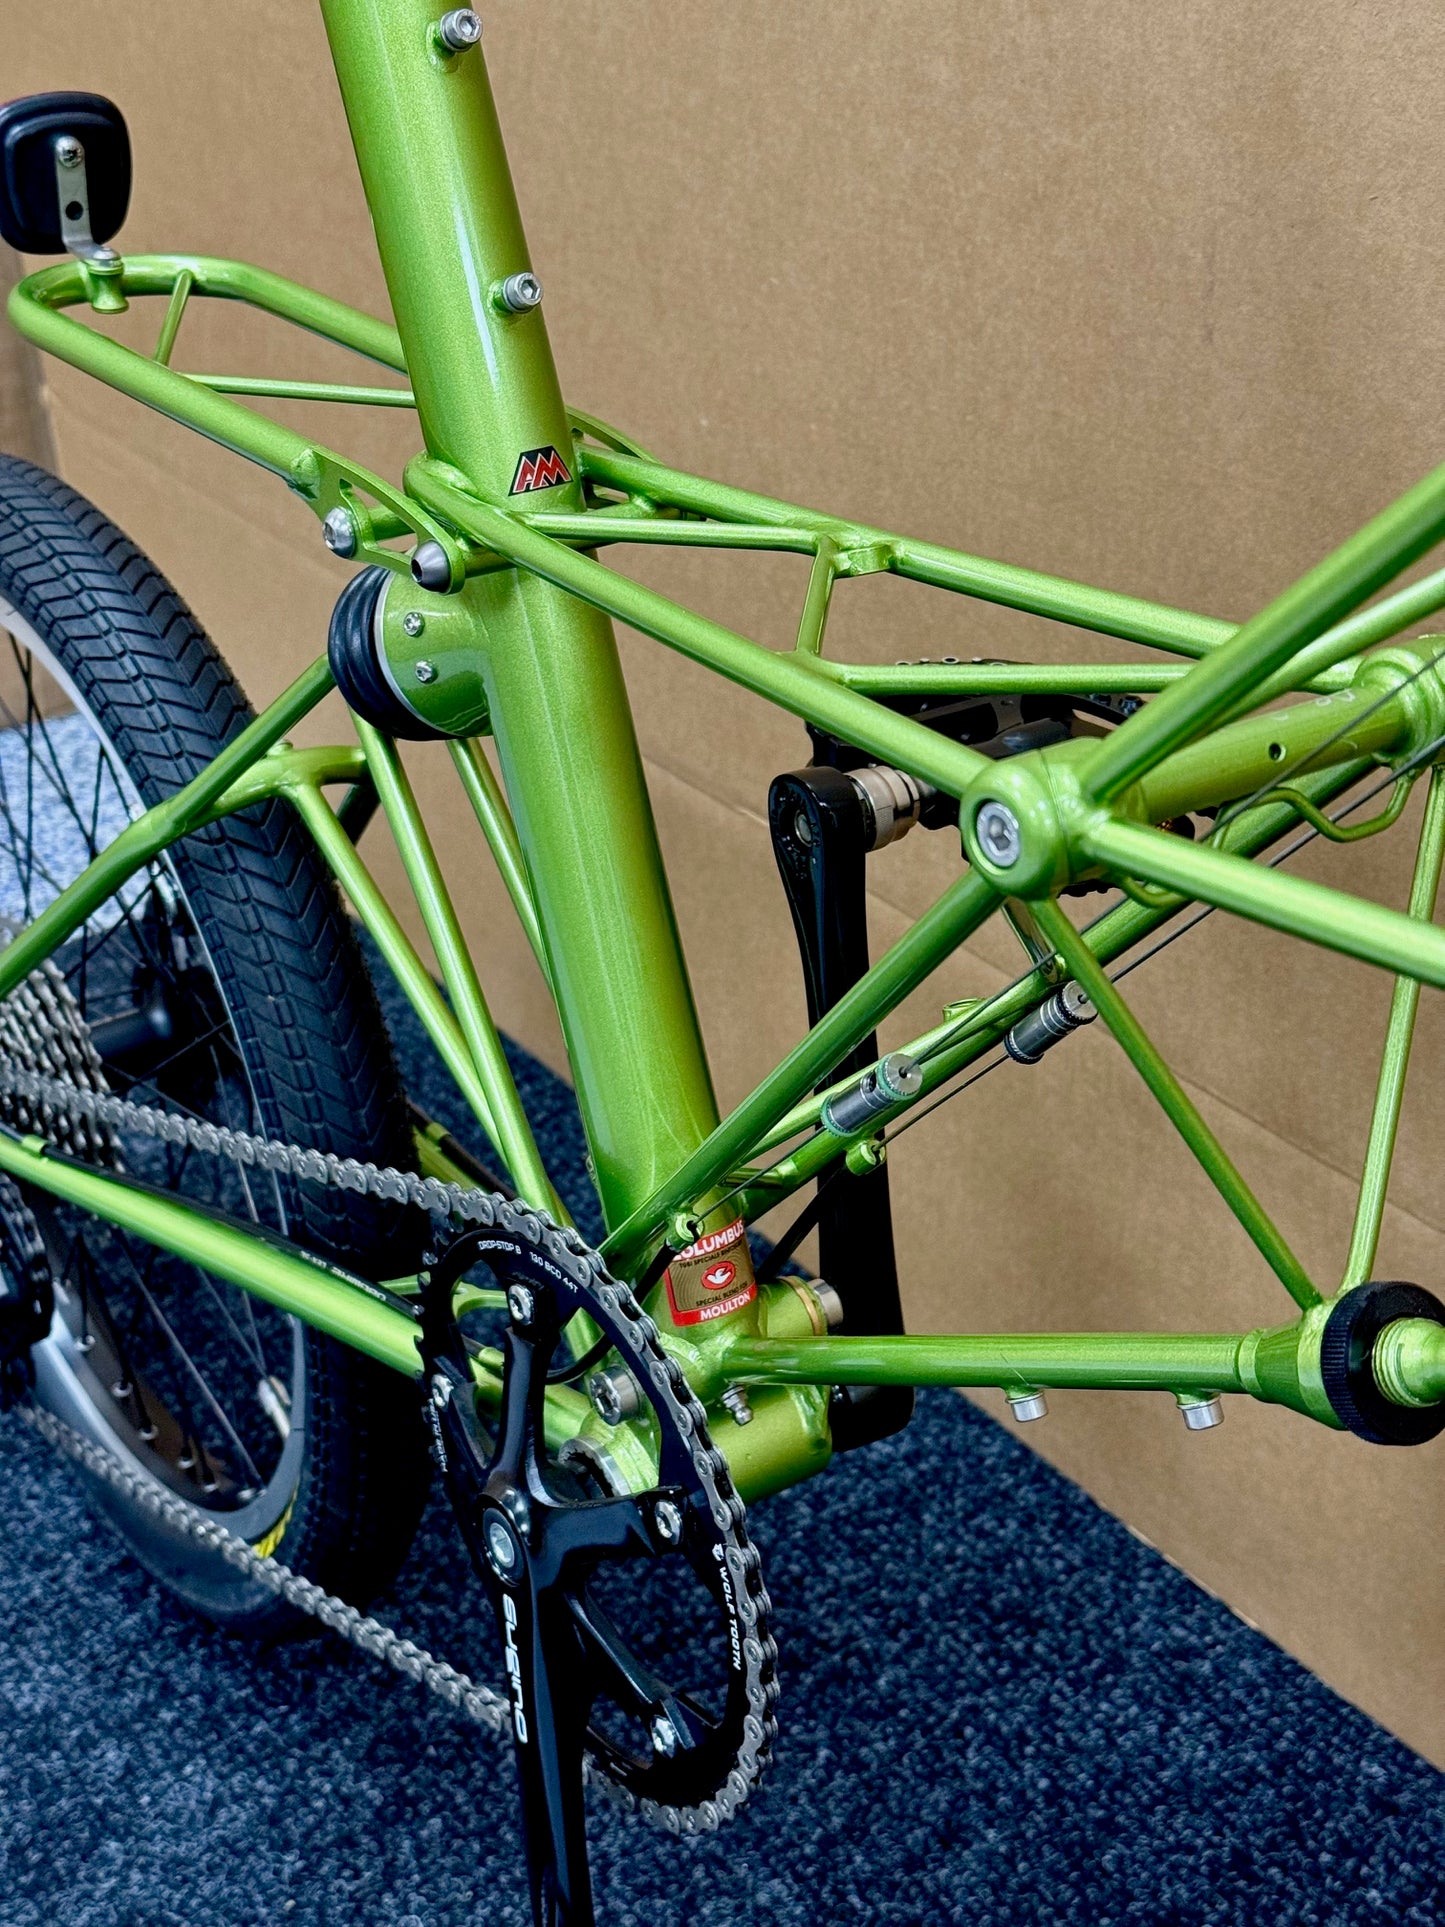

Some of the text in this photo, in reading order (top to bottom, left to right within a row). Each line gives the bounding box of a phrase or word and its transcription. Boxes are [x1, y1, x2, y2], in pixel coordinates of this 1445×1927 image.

[512, 450, 572, 493] AM
[478, 1240, 514, 1251] DROP-STOP
[529, 1251, 543, 1266] 130
[544, 1261, 562, 1279] BCD
[563, 1277, 578, 1293] 44T
[696, 1295, 722, 1306] SPECIAL
[700, 1291, 751, 1321] MOULTON
[719, 1566, 742, 1671] WOLF TOOTH
[503, 1593, 528, 1744] SUGINO
